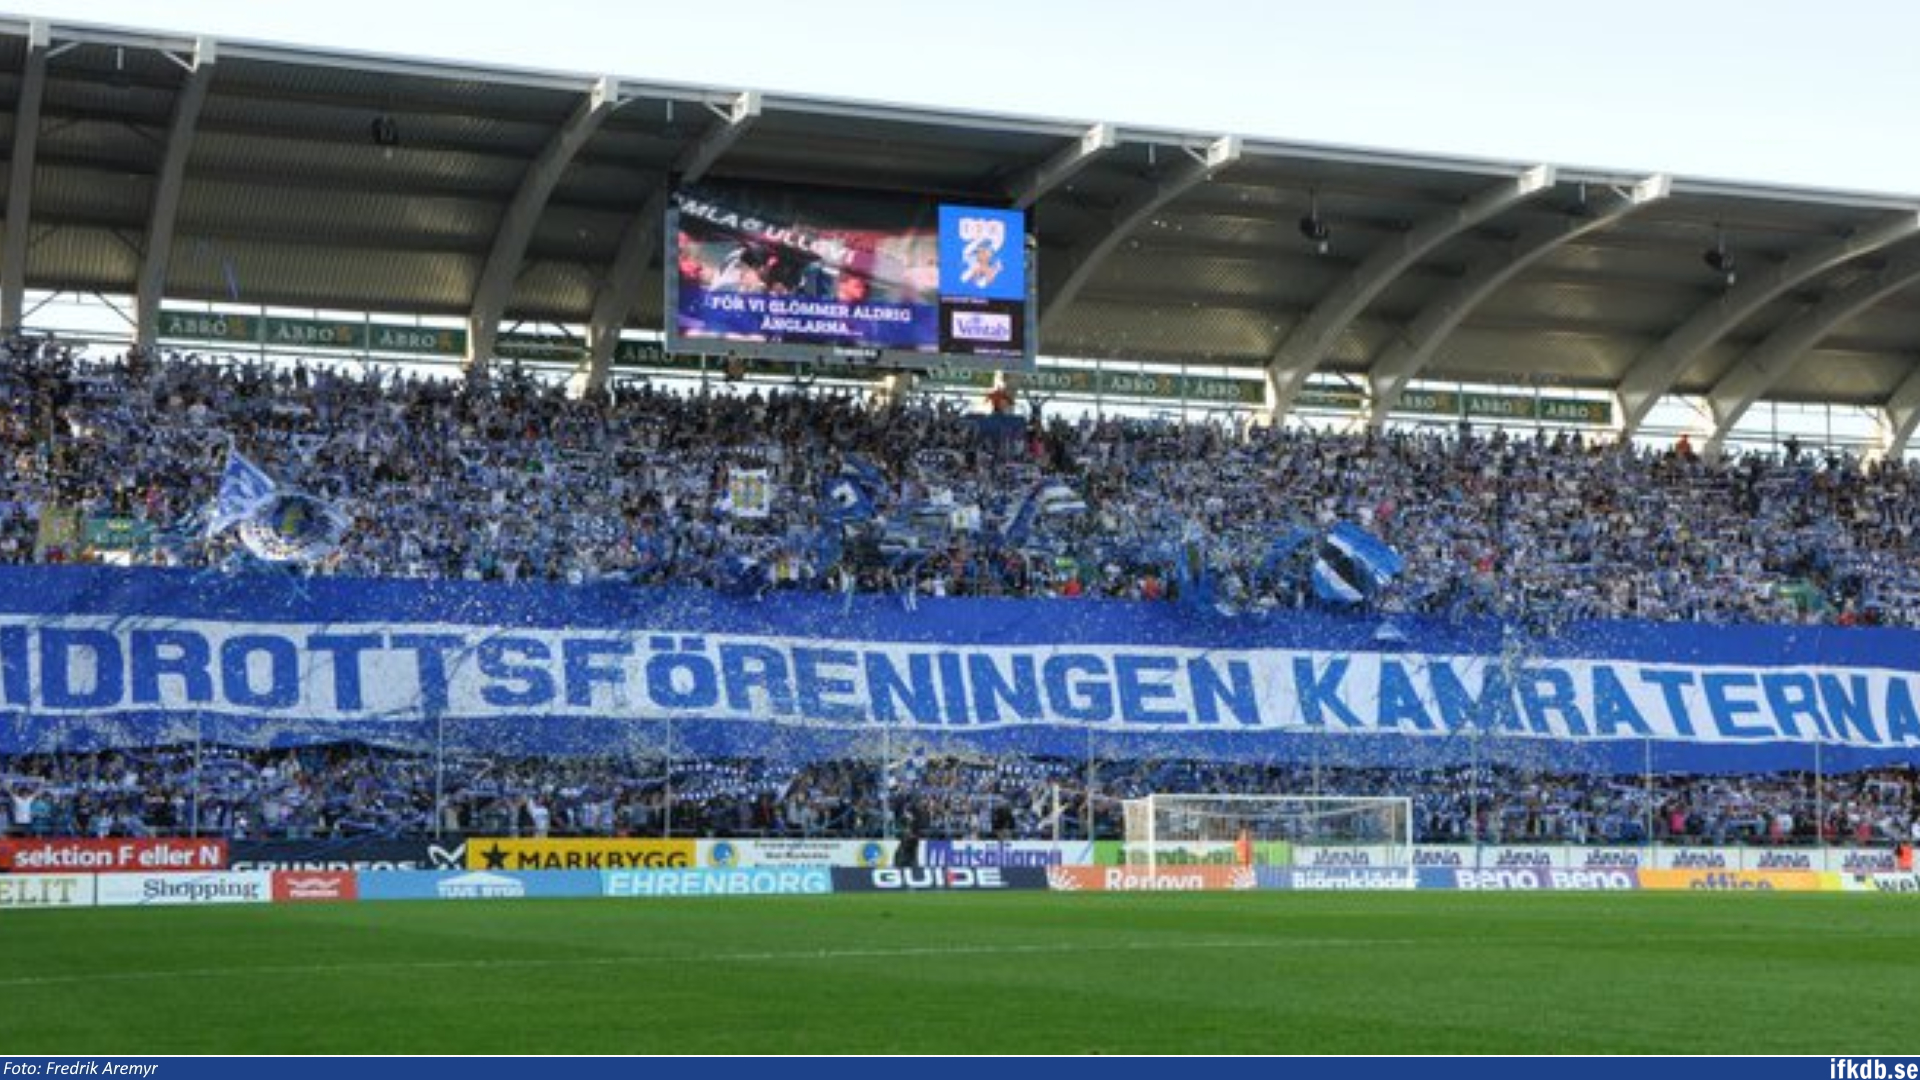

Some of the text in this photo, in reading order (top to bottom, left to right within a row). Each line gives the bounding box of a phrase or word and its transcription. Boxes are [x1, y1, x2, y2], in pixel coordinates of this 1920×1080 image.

[749, 299, 765, 312] VI
[853, 306, 911, 322] ALDRIG
[169, 318, 226, 336] ÅBRO
[277, 323, 335, 342] ÅBRO
[380, 330, 436, 348] ÅBRO
[1111, 373, 1156, 392] ÅBRO
[1195, 380, 1240, 397] ÅBRO
[0, 624, 1920, 744] IDROTTSFÖRENINGEN KAMRATERNA
[15, 846, 220, 868] sektion F eller N
[517, 851, 689, 868] MARKBYGG
[607, 871, 827, 895] EHRENBORG
[872, 868, 1008, 889] GUIDE
[0, 878, 77, 903] ELIT
[143, 879, 259, 900] Shopping
